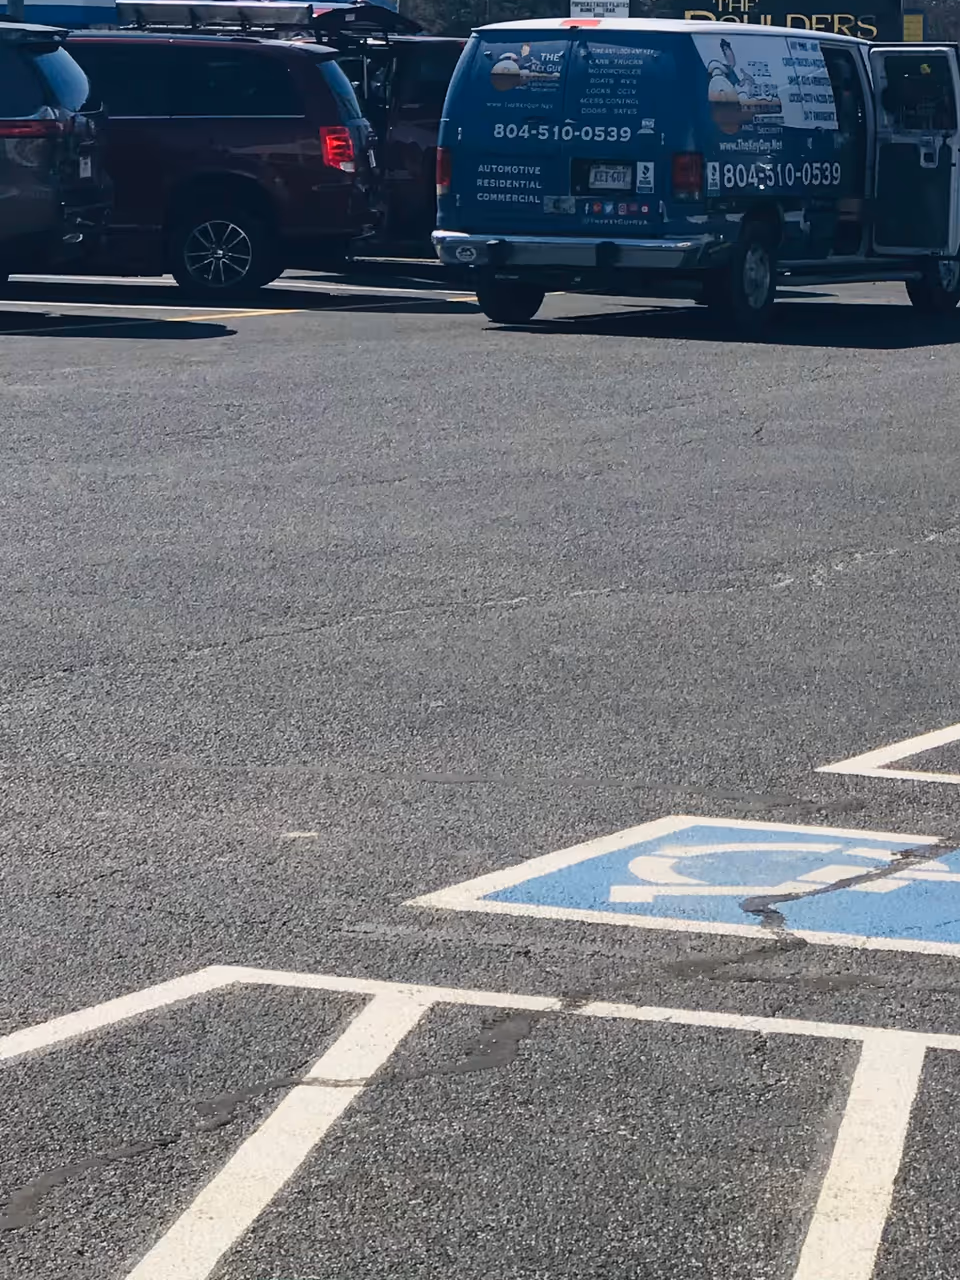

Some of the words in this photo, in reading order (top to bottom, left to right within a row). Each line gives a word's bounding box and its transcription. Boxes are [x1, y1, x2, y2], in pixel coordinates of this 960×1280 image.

[541, 52, 561, 62] THE
[493, 123, 632, 142] 804-510-0539
[719, 138, 783, 153] www.TheKeyGuy.Net
[478, 164, 541, 174] AUTOMOTIVE
[723, 161, 841, 188] 804-510-0539
[476, 178, 542, 189] RESIDENTIAL
[476, 192, 541, 203] COMMERCIAL
